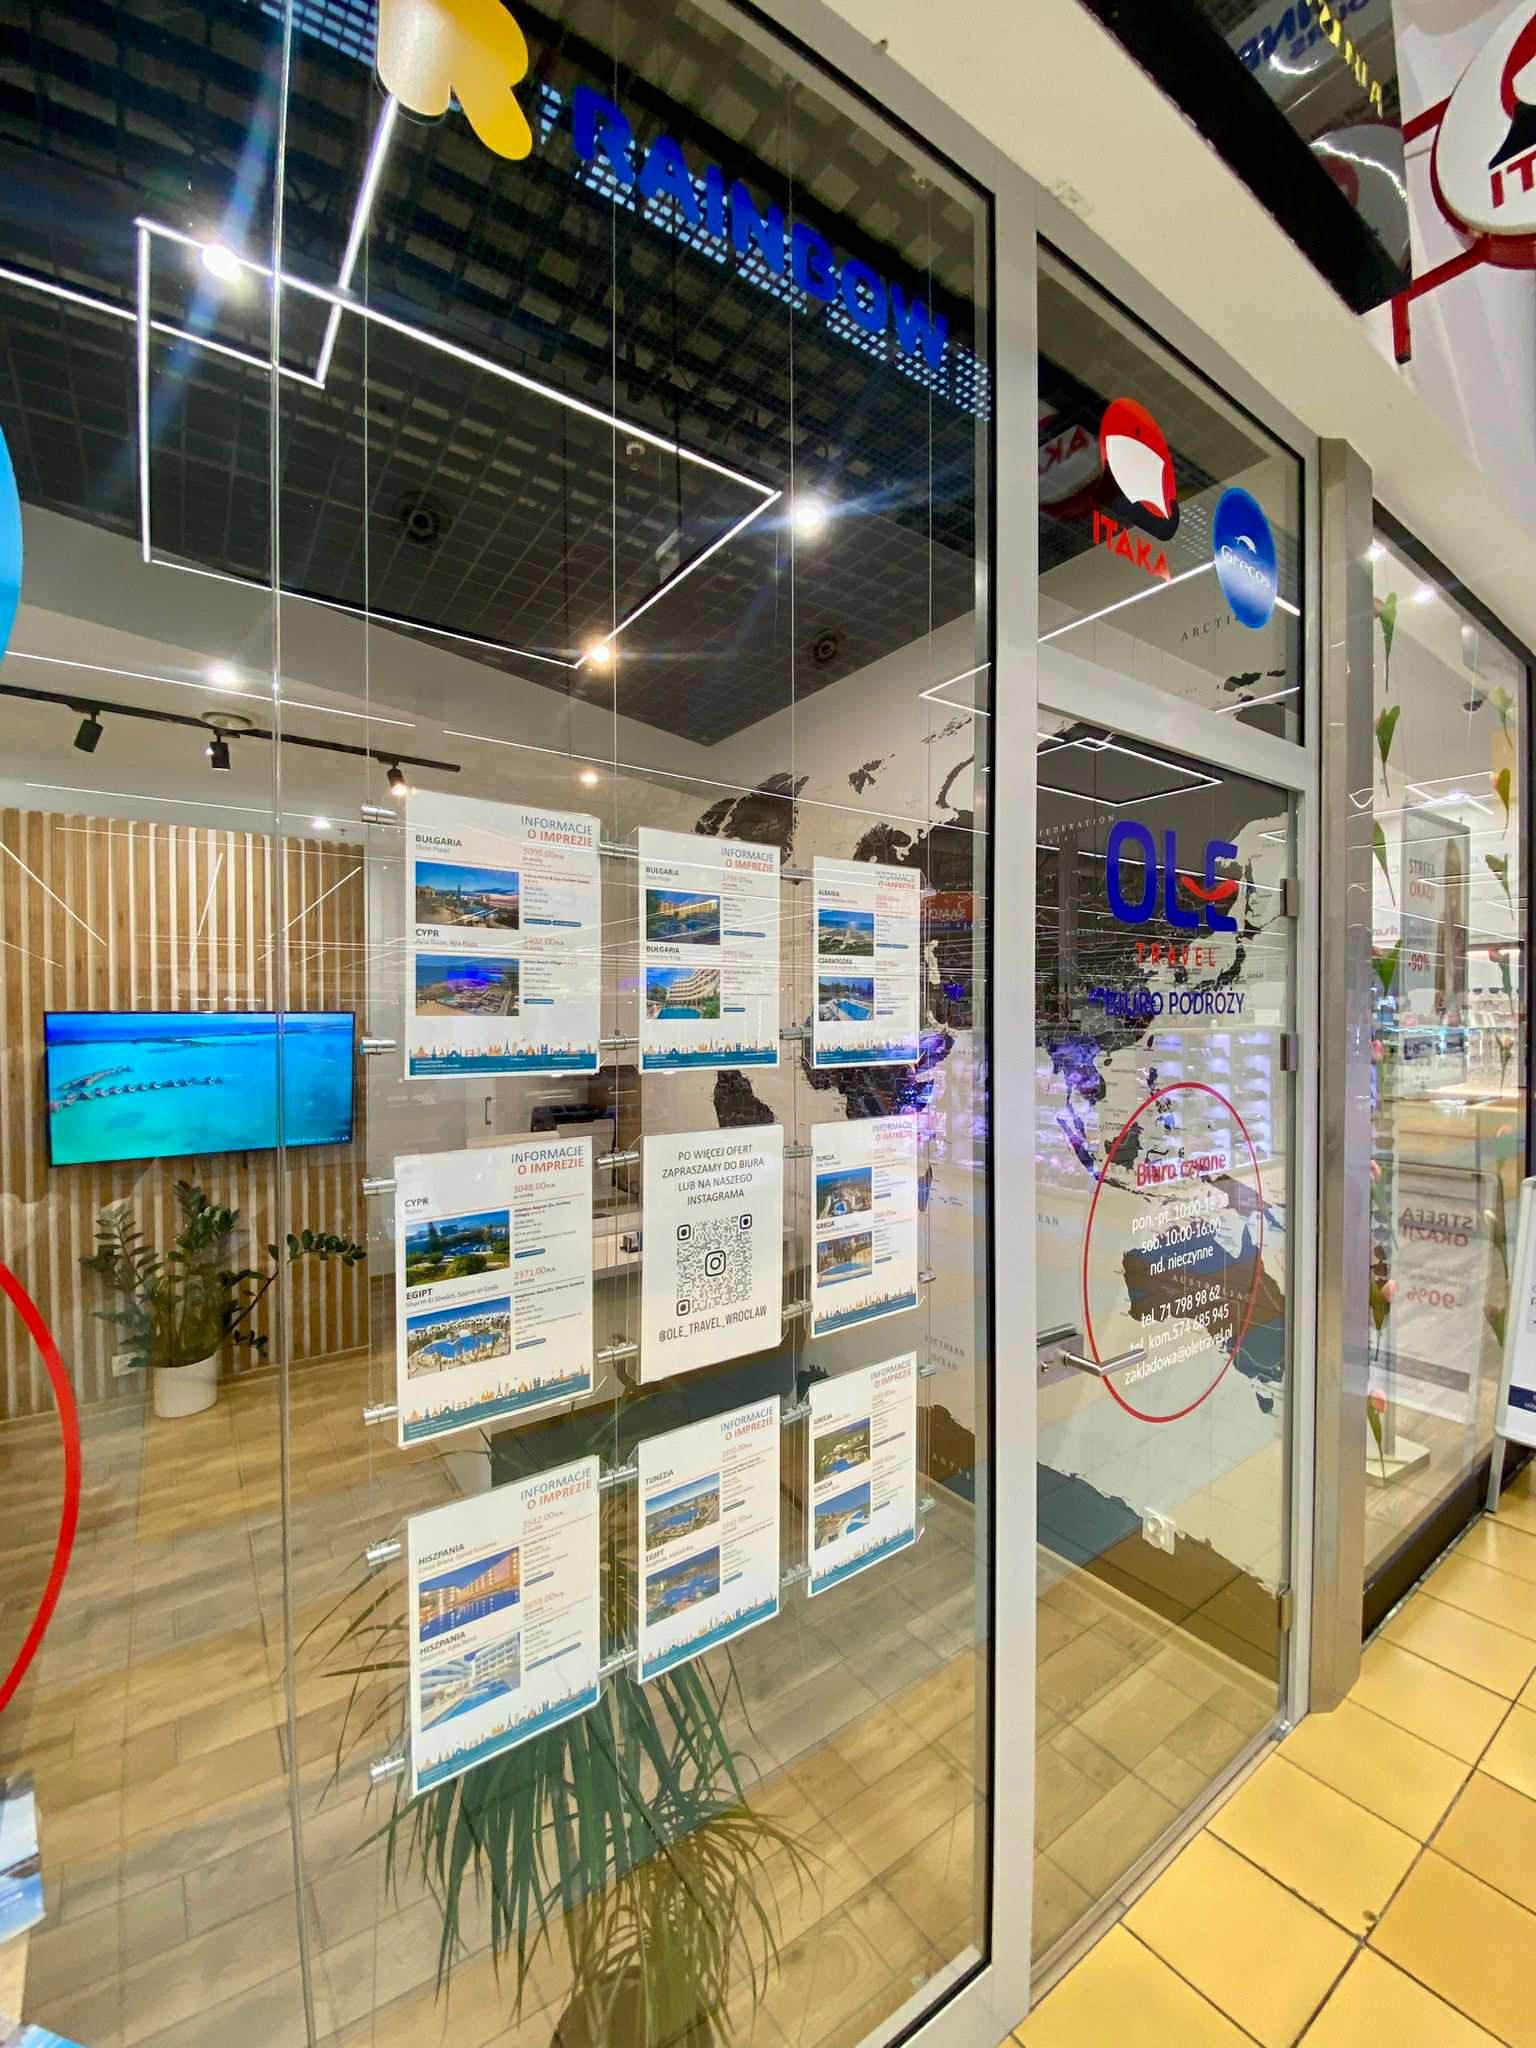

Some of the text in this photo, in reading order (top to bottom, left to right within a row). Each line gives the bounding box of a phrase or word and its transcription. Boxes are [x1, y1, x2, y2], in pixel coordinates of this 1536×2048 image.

[572, 85, 948, 371] RAINBOW
[1093, 511, 1171, 584] ITAKA
[521, 816, 592, 835] INFORMACJE
[416, 835, 462, 847] BUŁGARIA
[528, 830, 592, 847] O IMPREZIE
[721, 848, 773, 862] INFORMACJE
[735, 860, 773, 872] IMPREZIE
[646, 866, 679, 876] BUŁGARIA
[416, 928, 439, 937] CYPR
[1136, 941, 1216, 967] TRAVEL
[512, 1146, 583, 1164] INFORMACJE
[678, 1144, 753, 1161] PO WIĘCEJ OFERT
[518, 1158, 584, 1175] O IMPREZIE
[662, 1157, 764, 1179] ZAPRASZAMY DO BIURA
[1136, 1153, 1226, 1187] Biuro czynne
[678, 1173, 753, 1192] LUB NA NASZEGO
[405, 1197, 428, 1208] CYPR
[687, 1189, 744, 1206] INSTAGRAMA
[1141, 1217, 1221, 1254] sob. 10:00-16:00
[1150, 1244, 1214, 1276] nd. nieczynne
[406, 1288, 432, 1300] EGIPT
[1160, 1302, 1171, 1321] 71
[1175, 1295, 1193, 1315] 798
[1195, 1289, 1207, 1307] 98
[1208, 1284, 1221, 1302] 62
[1193, 1310, 1210, 1330] 685
[1212, 1304, 1229, 1323] 945
[1125, 1324, 1233, 1385] zakladowa@oletravel.pl
[720, 1406, 774, 1433] INFORMACJE
[725, 1417, 774, 1441] O IMPREZIE
[521, 1467, 592, 1500] INFORMACJE
[527, 1479, 592, 1510] O IMPREZIE
[418, 1543, 464, 1566] HISZPANIA
[645, 1549, 665, 1563] EGIPT
[420, 1631, 466, 1655] HISZPANIA
